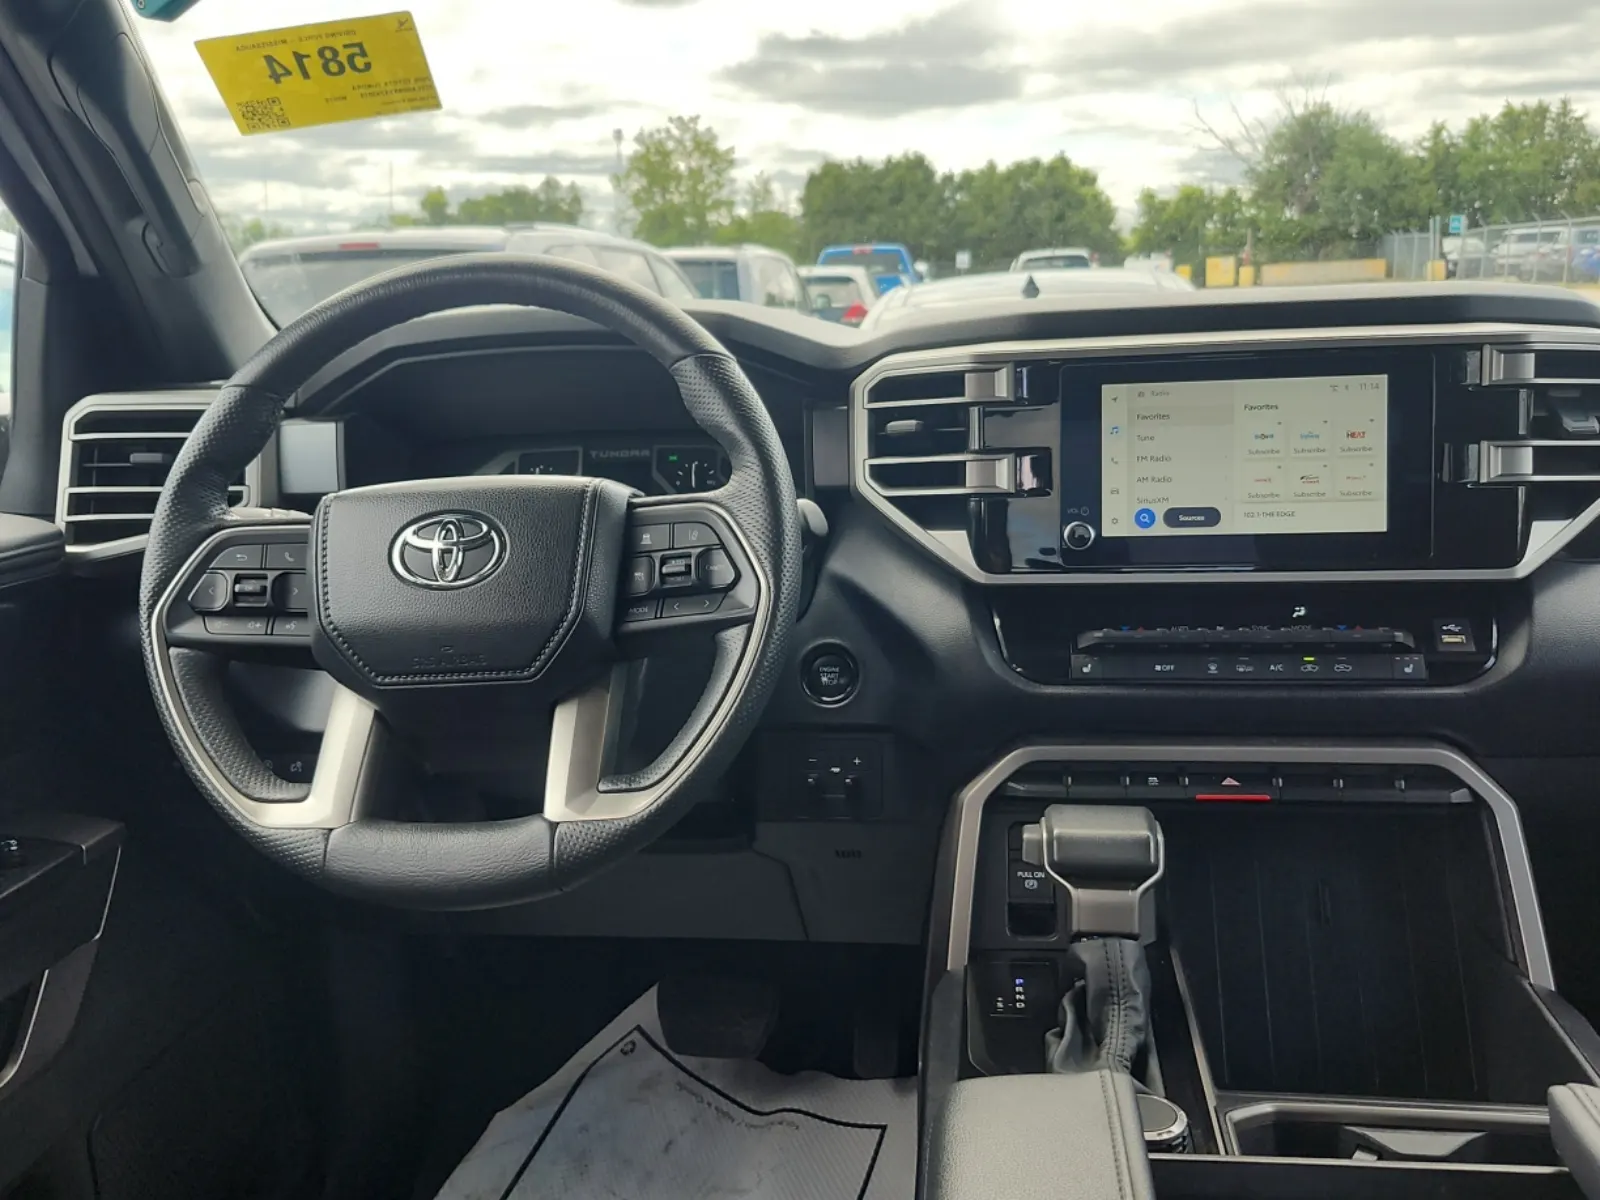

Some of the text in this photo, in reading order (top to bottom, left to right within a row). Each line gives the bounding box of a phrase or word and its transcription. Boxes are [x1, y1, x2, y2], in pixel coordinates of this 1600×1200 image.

[1244, 403, 1278, 411] Favorites
[1136, 412, 1170, 421] Favorites
[1136, 434, 1155, 442] Tune
[1248, 448, 1280, 456] Subscribe
[1293, 447, 1326, 455] Subscribe
[1339, 445, 1373, 453] Subscribe
[589, 449, 650, 460] TUNDRA
[1136, 454, 1171, 463] FM Radio
[1136, 475, 1173, 484] AM Radio
[1248, 491, 1280, 500] Subscribe
[1293, 490, 1326, 499] Subscribe
[1339, 489, 1372, 497] Subscribe
[1269, 664, 1284, 672] A/C
